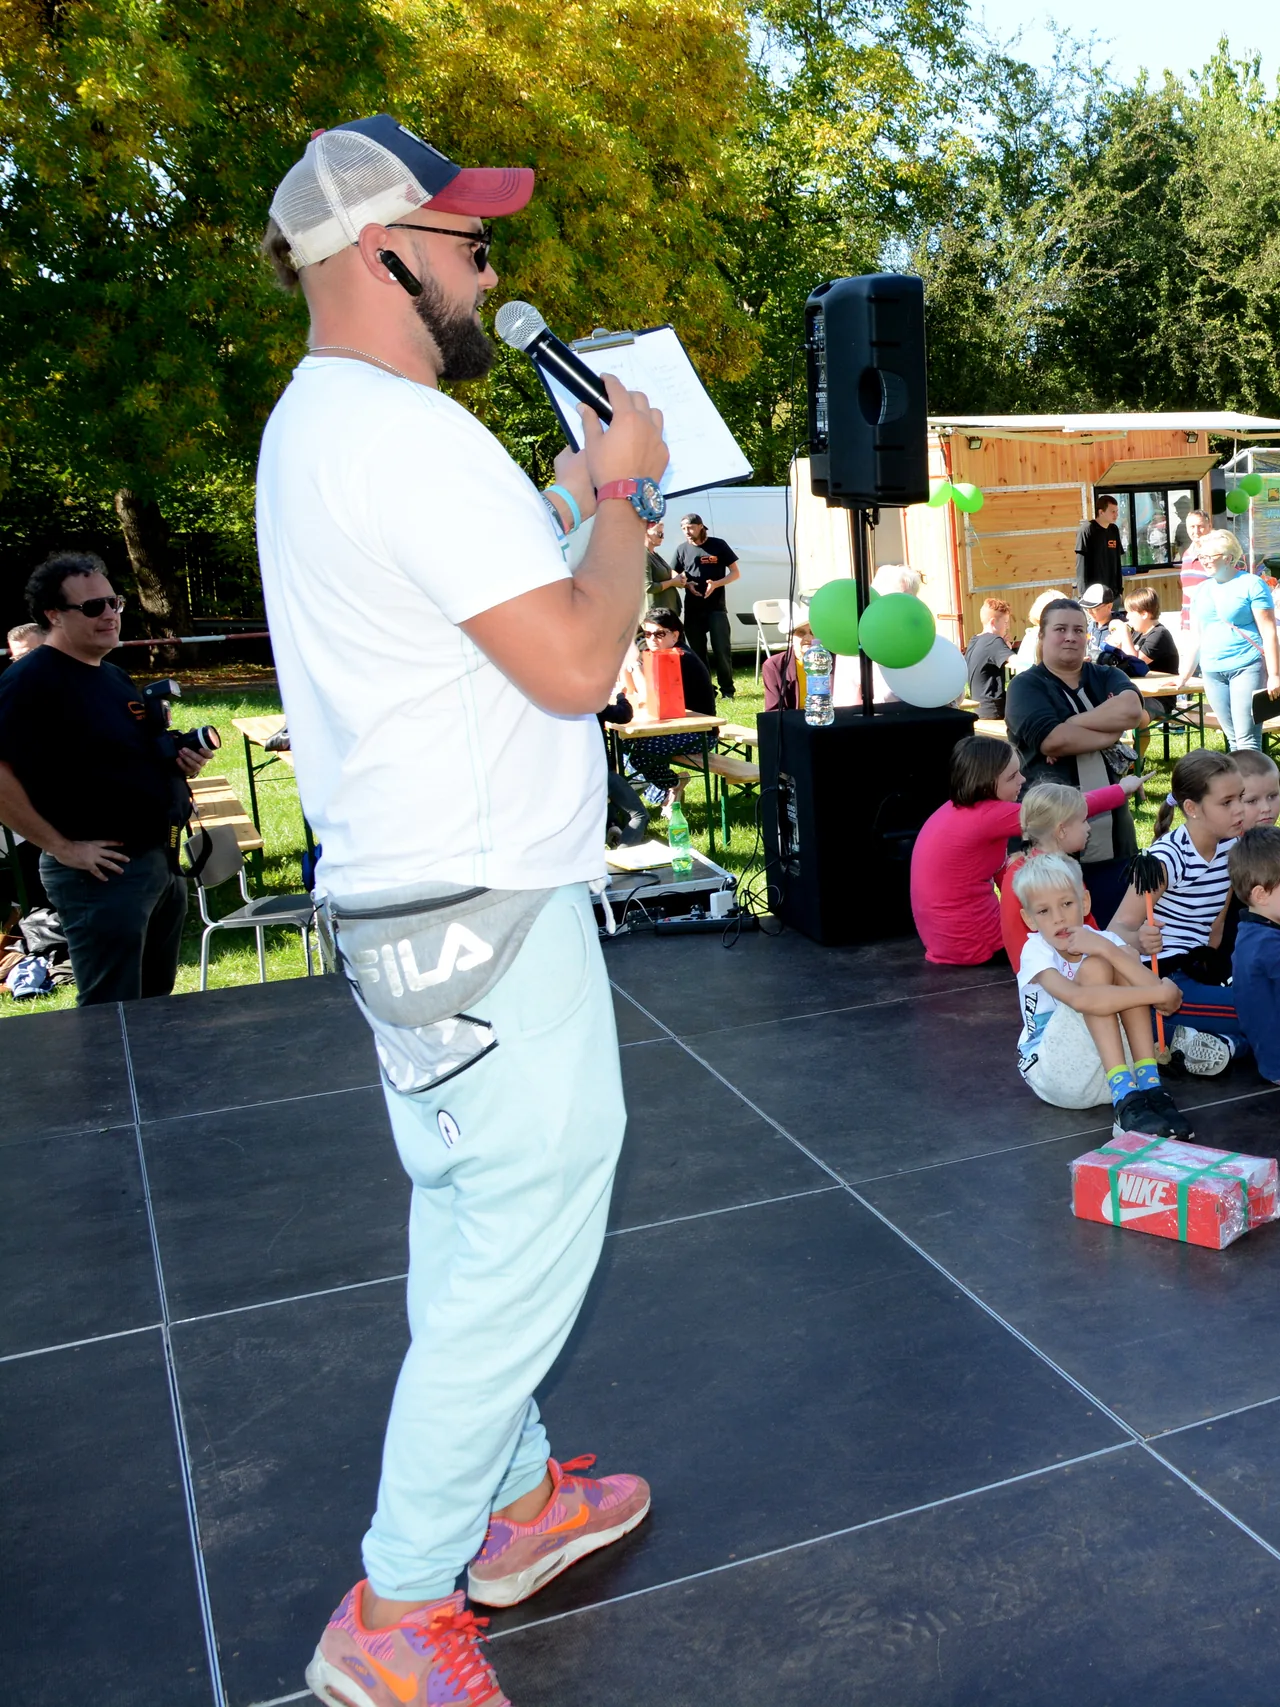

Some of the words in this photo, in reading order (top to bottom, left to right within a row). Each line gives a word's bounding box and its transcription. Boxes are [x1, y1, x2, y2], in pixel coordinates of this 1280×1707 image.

[170, 825, 178, 848] Nikon
[353, 922, 494, 998] FILA
[1117, 1172, 1170, 1206] NIKE
